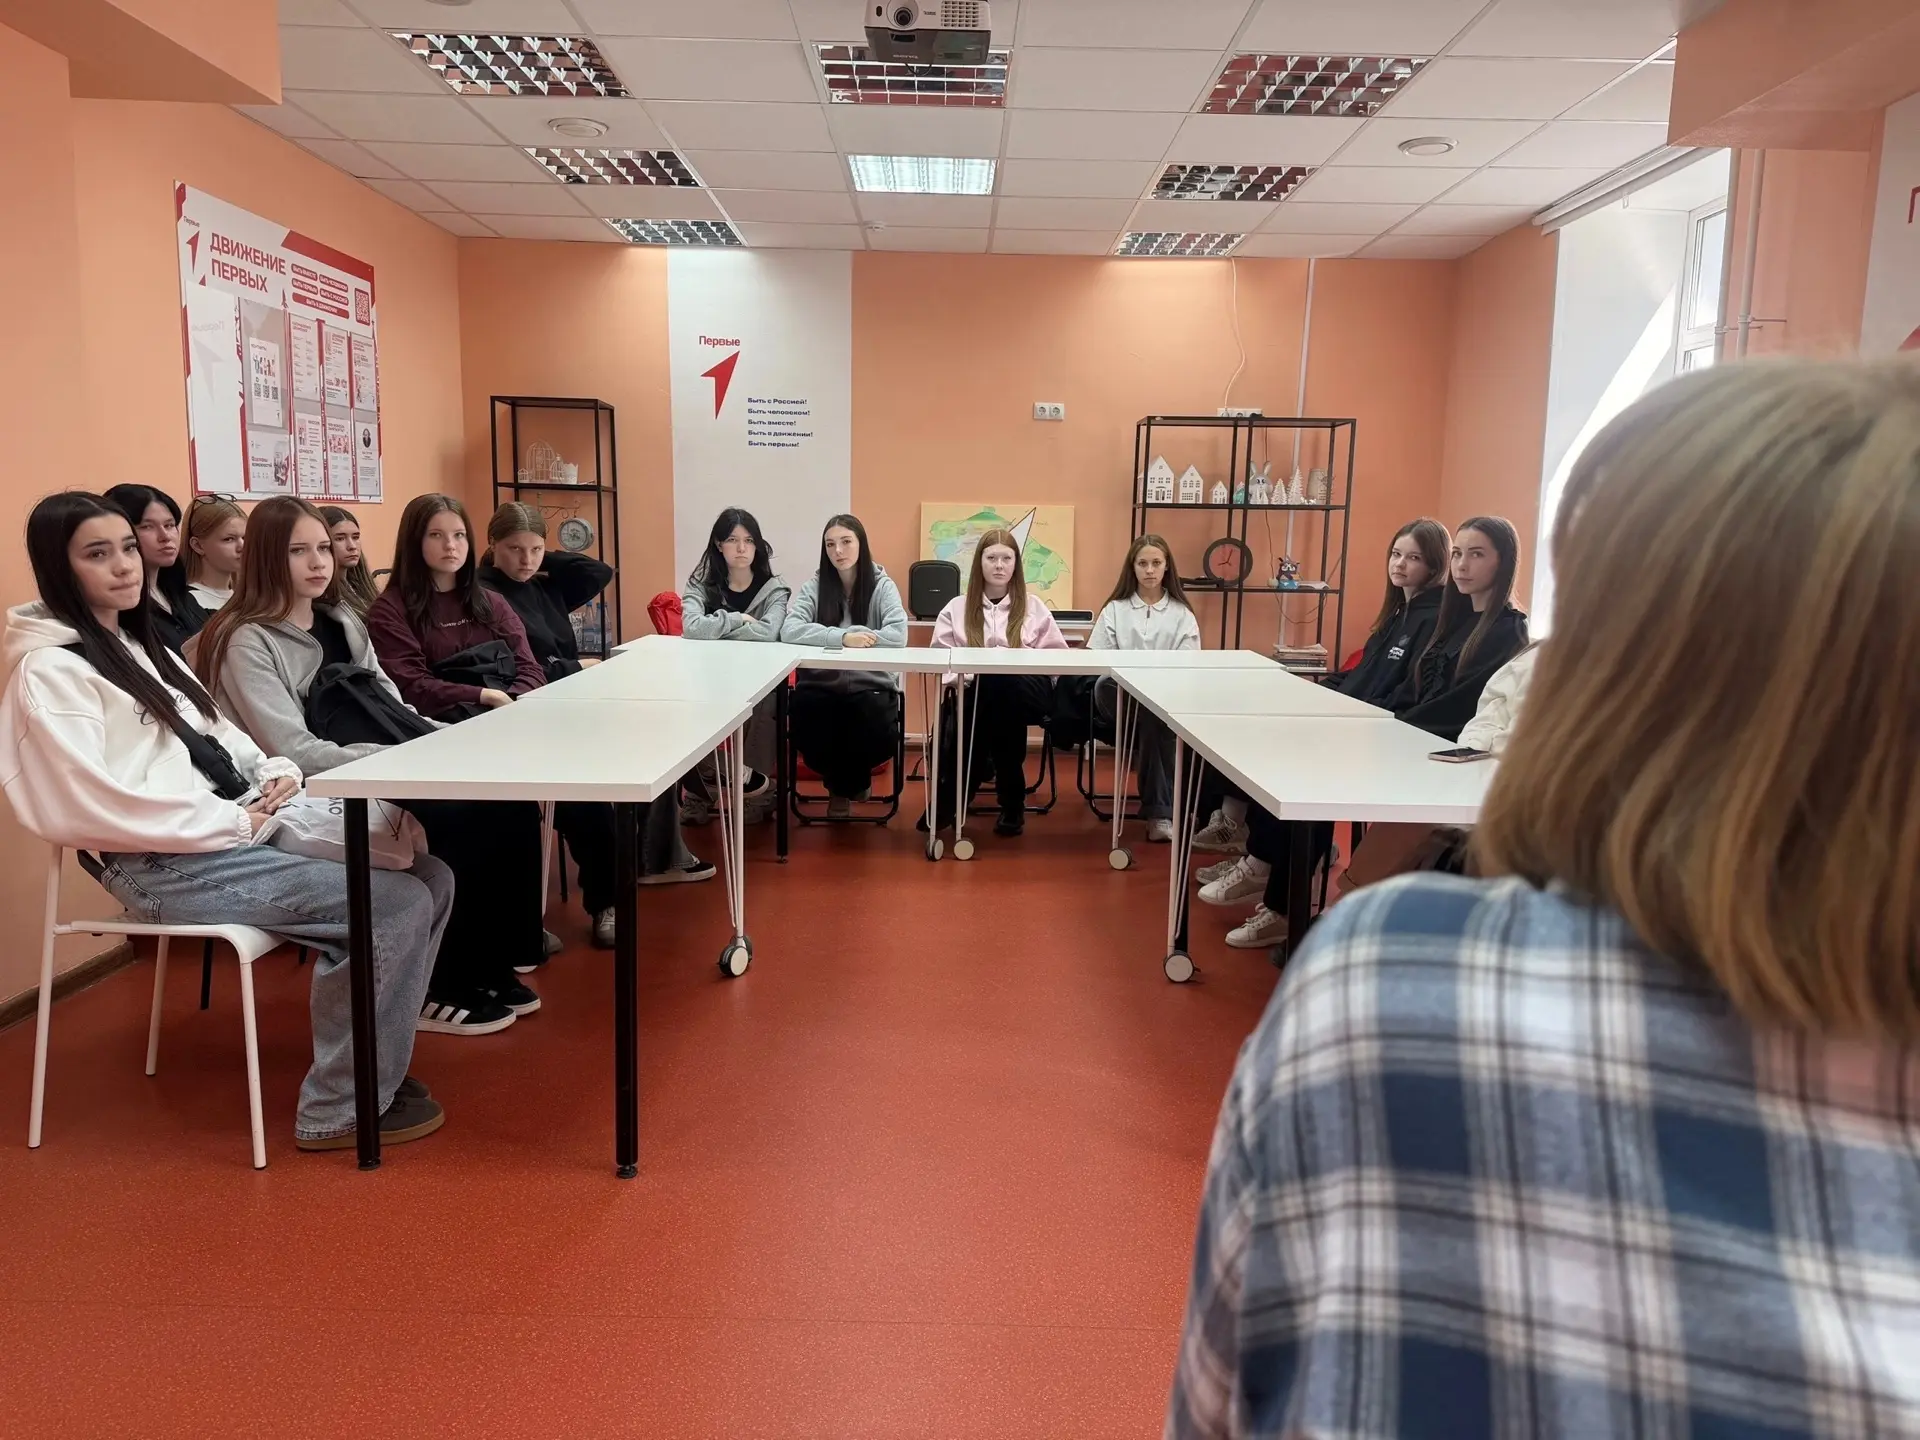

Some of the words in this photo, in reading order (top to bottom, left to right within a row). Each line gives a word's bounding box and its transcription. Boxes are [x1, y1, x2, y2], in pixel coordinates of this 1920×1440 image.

[210, 232, 287, 276] ДВИЖЕНИЕ
[211, 258, 268, 293] ПЕРВЫХ
[699, 335, 741, 348] Первые
